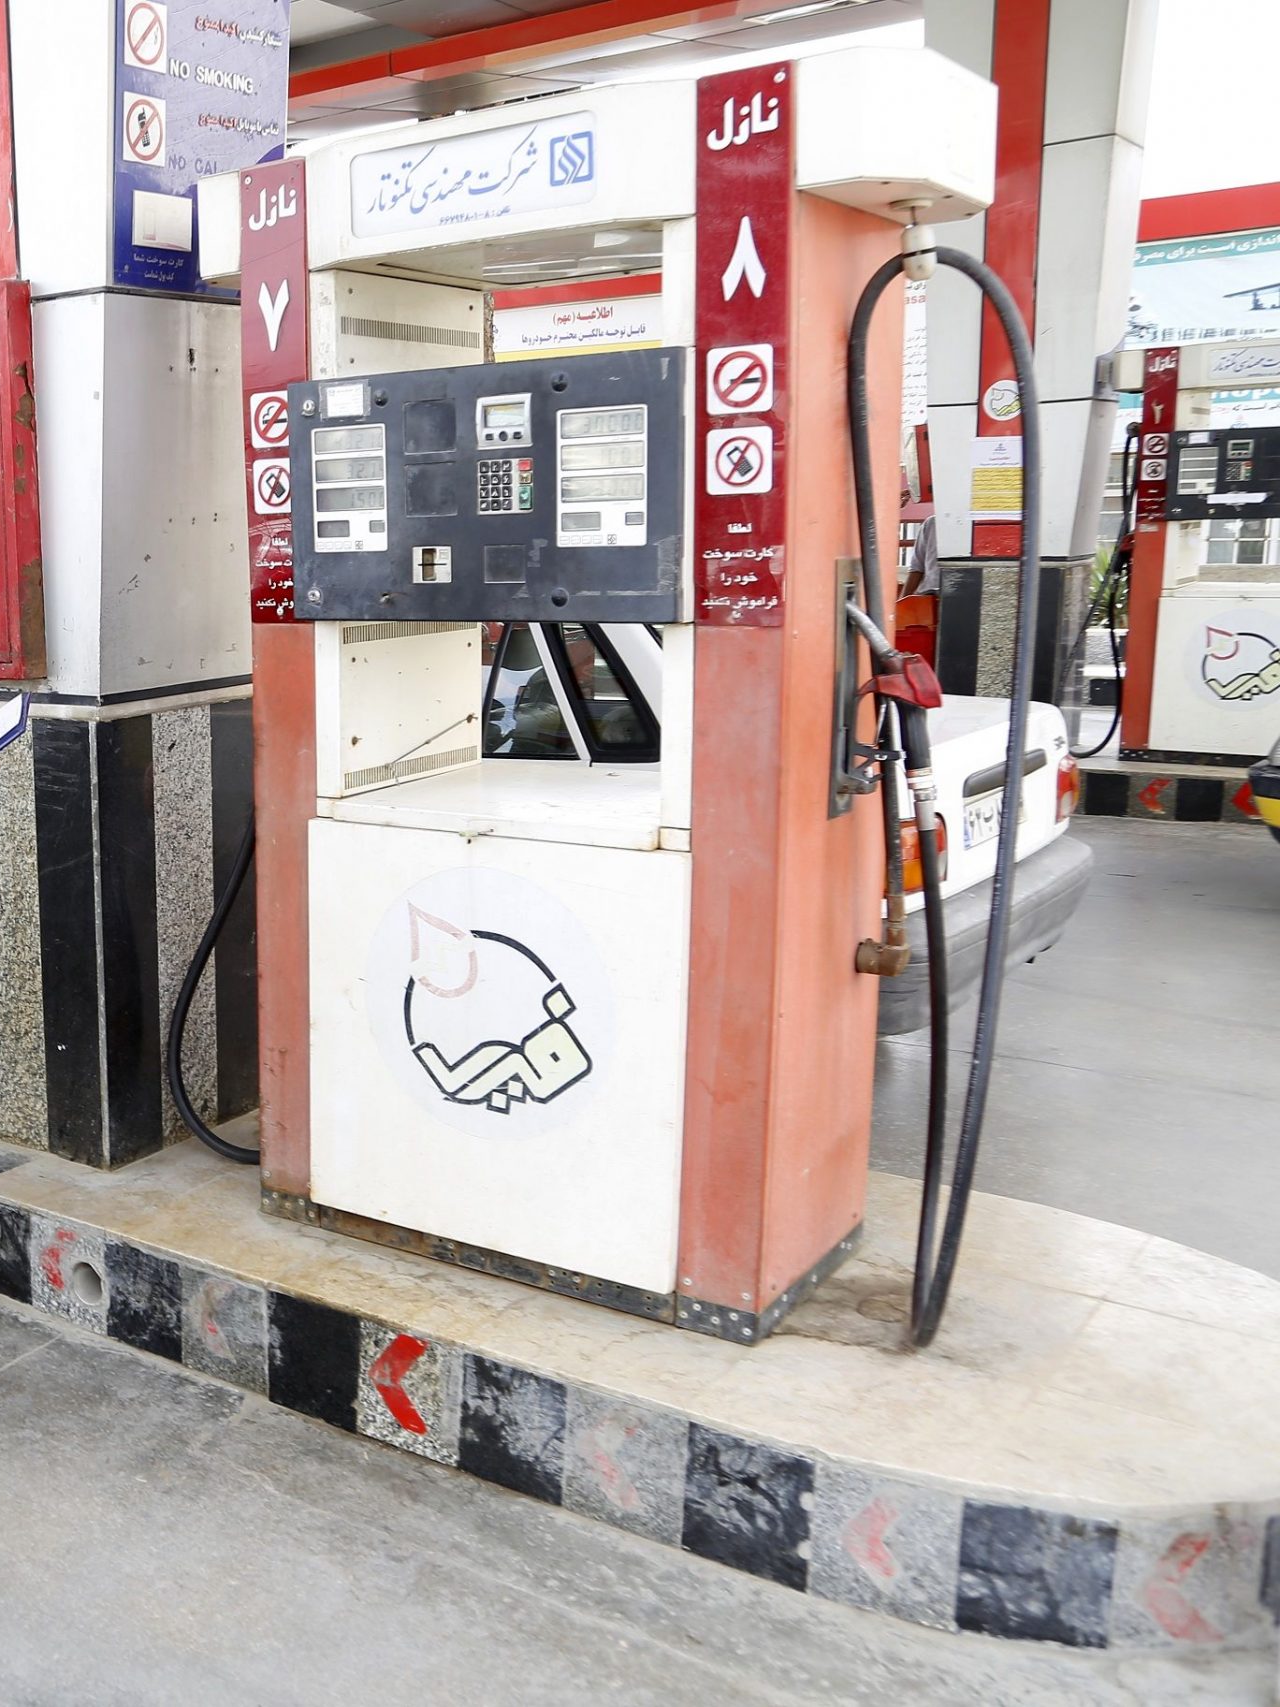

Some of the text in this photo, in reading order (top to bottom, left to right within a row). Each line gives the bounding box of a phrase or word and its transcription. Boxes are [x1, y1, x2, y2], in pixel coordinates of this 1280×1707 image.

[169, 58, 254, 95] NO SMOKING
[706, 91, 780, 151] نازل
[168, 153, 187, 171] NO
[248, 184, 298, 231] نازل
[721, 215, 767, 302] ۸
[258, 278, 290, 352] ۷
[576, 306, 614, 323] اطلاعیه
[727, 522, 752, 534] لطفا
[272, 537, 288, 546] لطفا
[702, 546, 775, 562] کارت سوخت
[255, 560, 283, 570] سوخت
[278, 577, 294, 590] خود
[720, 572, 758, 586] خود را
[701, 596, 778, 610] فراموش نکنید
